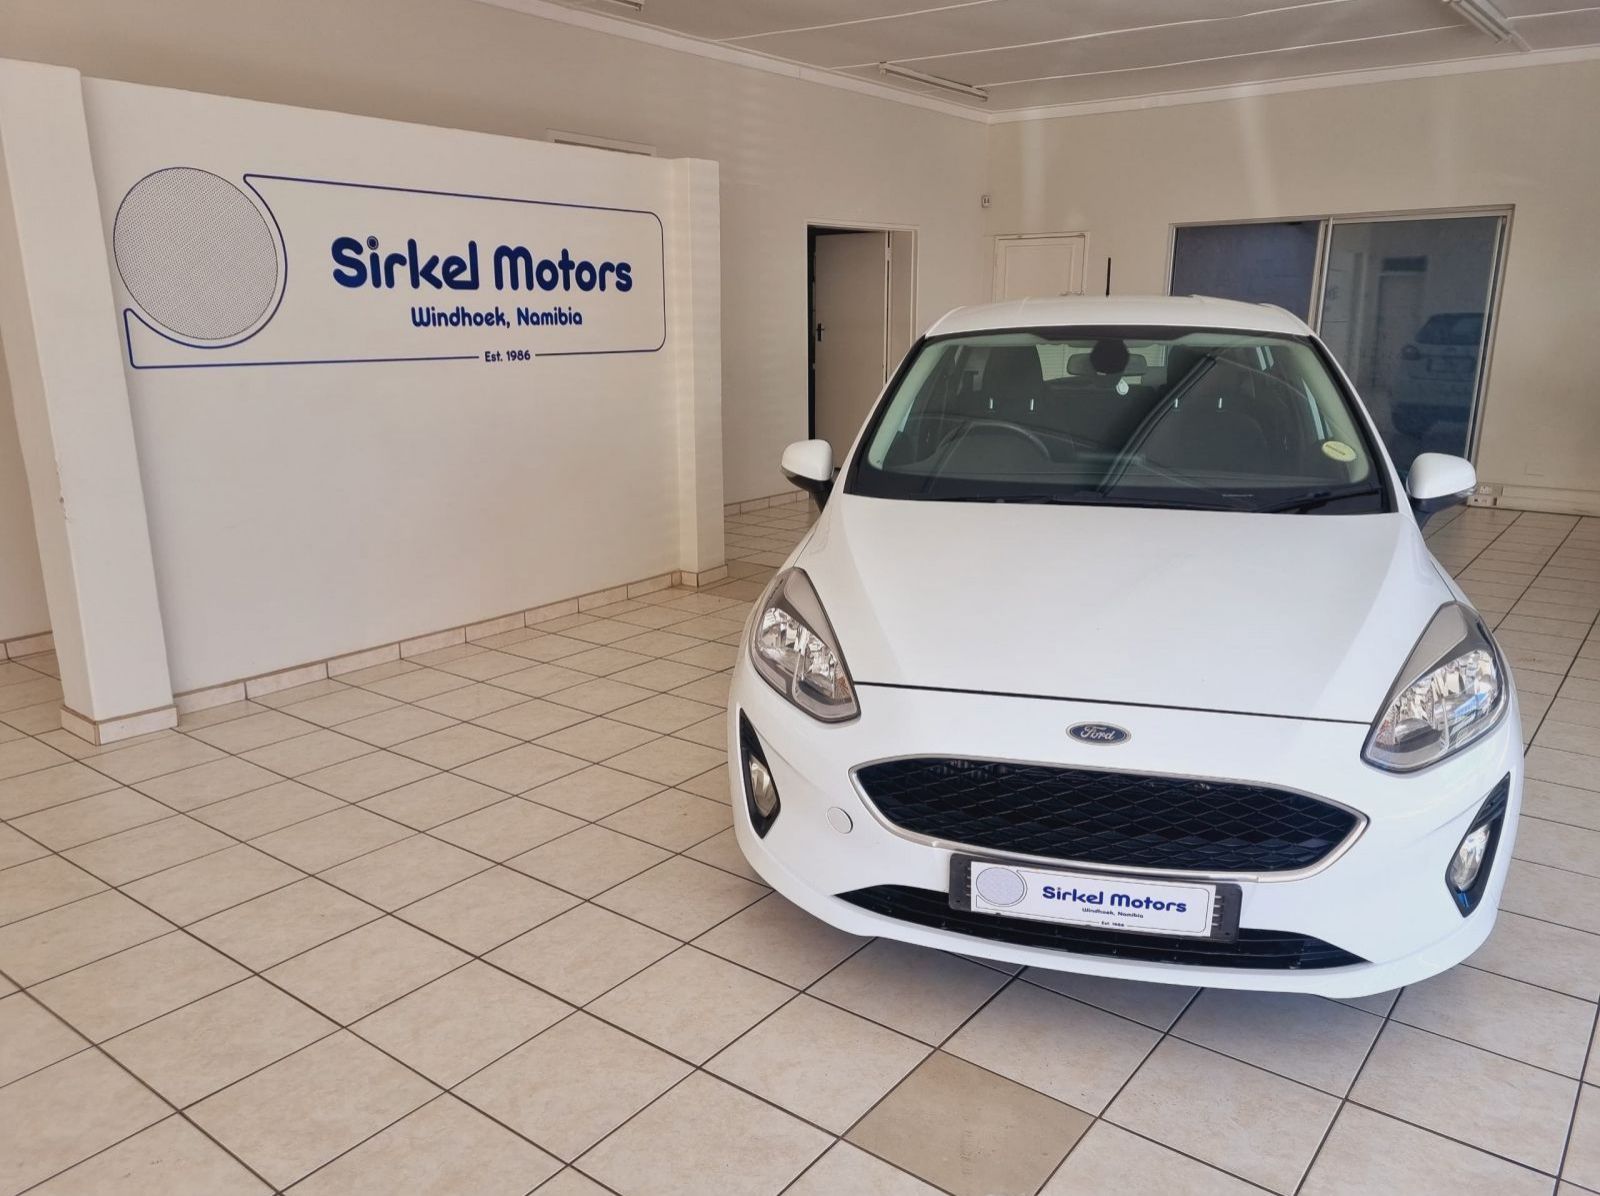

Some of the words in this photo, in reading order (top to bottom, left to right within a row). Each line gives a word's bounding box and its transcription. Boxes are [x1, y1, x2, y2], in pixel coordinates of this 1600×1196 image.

[331, 236, 479, 291] Sirkel
[493, 244, 633, 293] Motors
[410, 306, 511, 330] Windhoek,
[516, 305, 583, 327] Namibia
[484, 350, 504, 363] Est.
[505, 349, 532, 362] 1986
[1080, 726, 1116, 740] Ford
[1042, 885, 1104, 906] Sirkel
[1109, 893, 1187, 913] Motors
